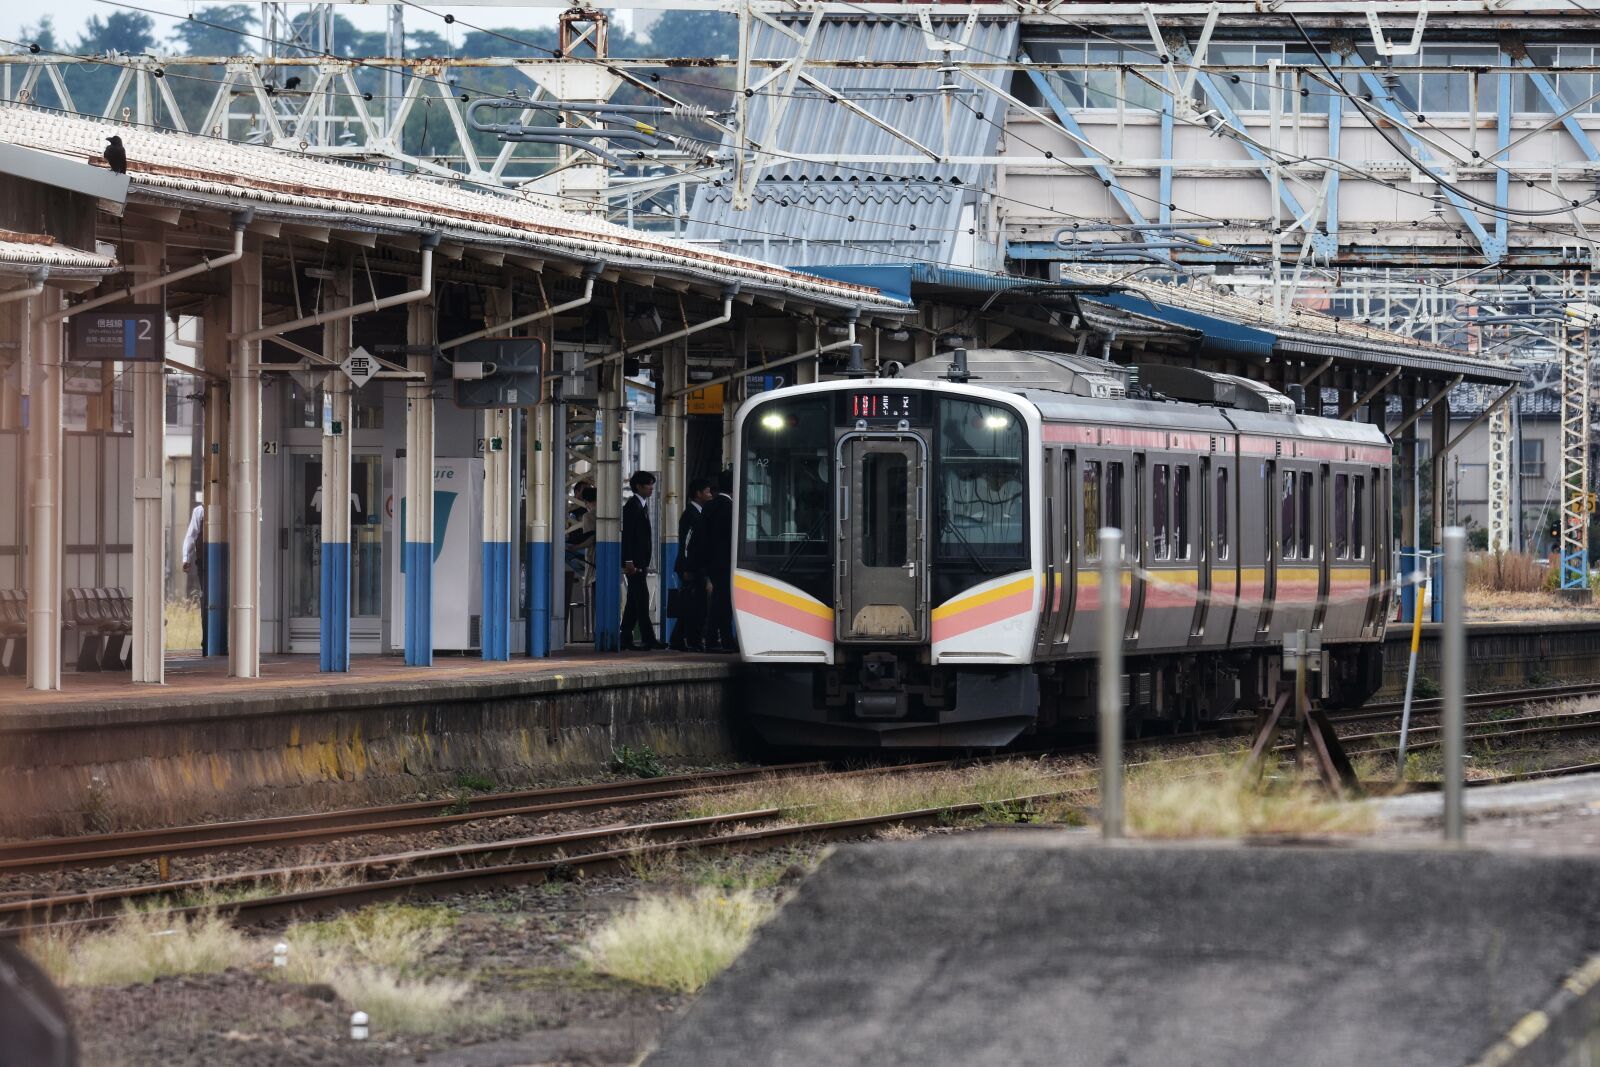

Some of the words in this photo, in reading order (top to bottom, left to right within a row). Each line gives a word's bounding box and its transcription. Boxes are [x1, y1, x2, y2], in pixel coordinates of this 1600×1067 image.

[138, 319, 152, 340] 2
[351, 357, 369, 376] 雪
[264, 442, 277, 454] 21
[434, 470, 455, 479] ure
[1002, 619, 1025, 631] JR
